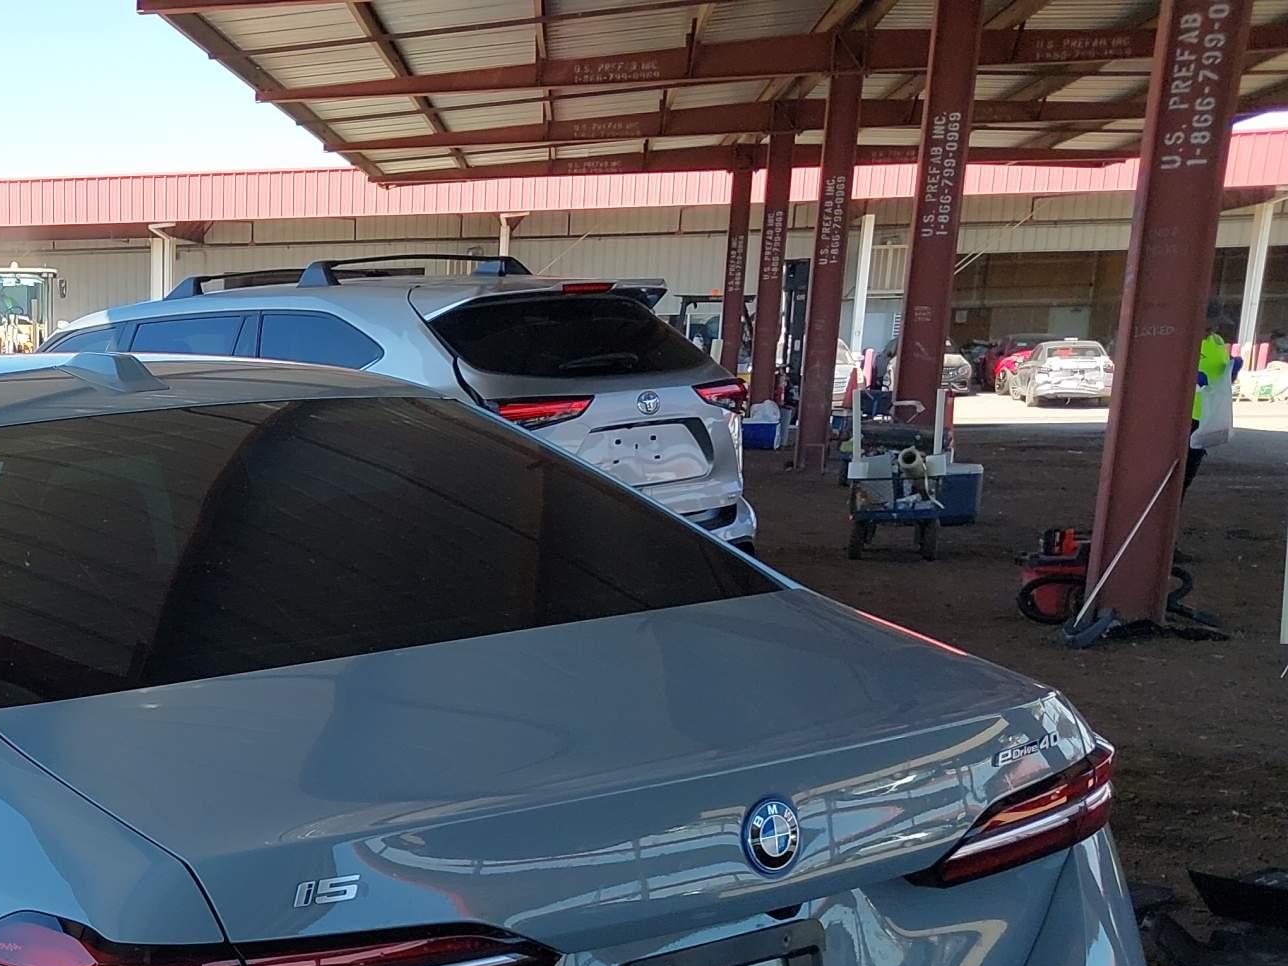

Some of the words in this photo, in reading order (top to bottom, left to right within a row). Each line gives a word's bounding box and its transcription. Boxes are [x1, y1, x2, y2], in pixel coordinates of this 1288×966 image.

[1168, 12, 1202, 109] PREFAB
[925, 146, 944, 202] PREFAB
[935, 111, 962, 235] 1-866-799-0969
[753, 804, 797, 834] BMW
[293, 873, 361, 909] i5
